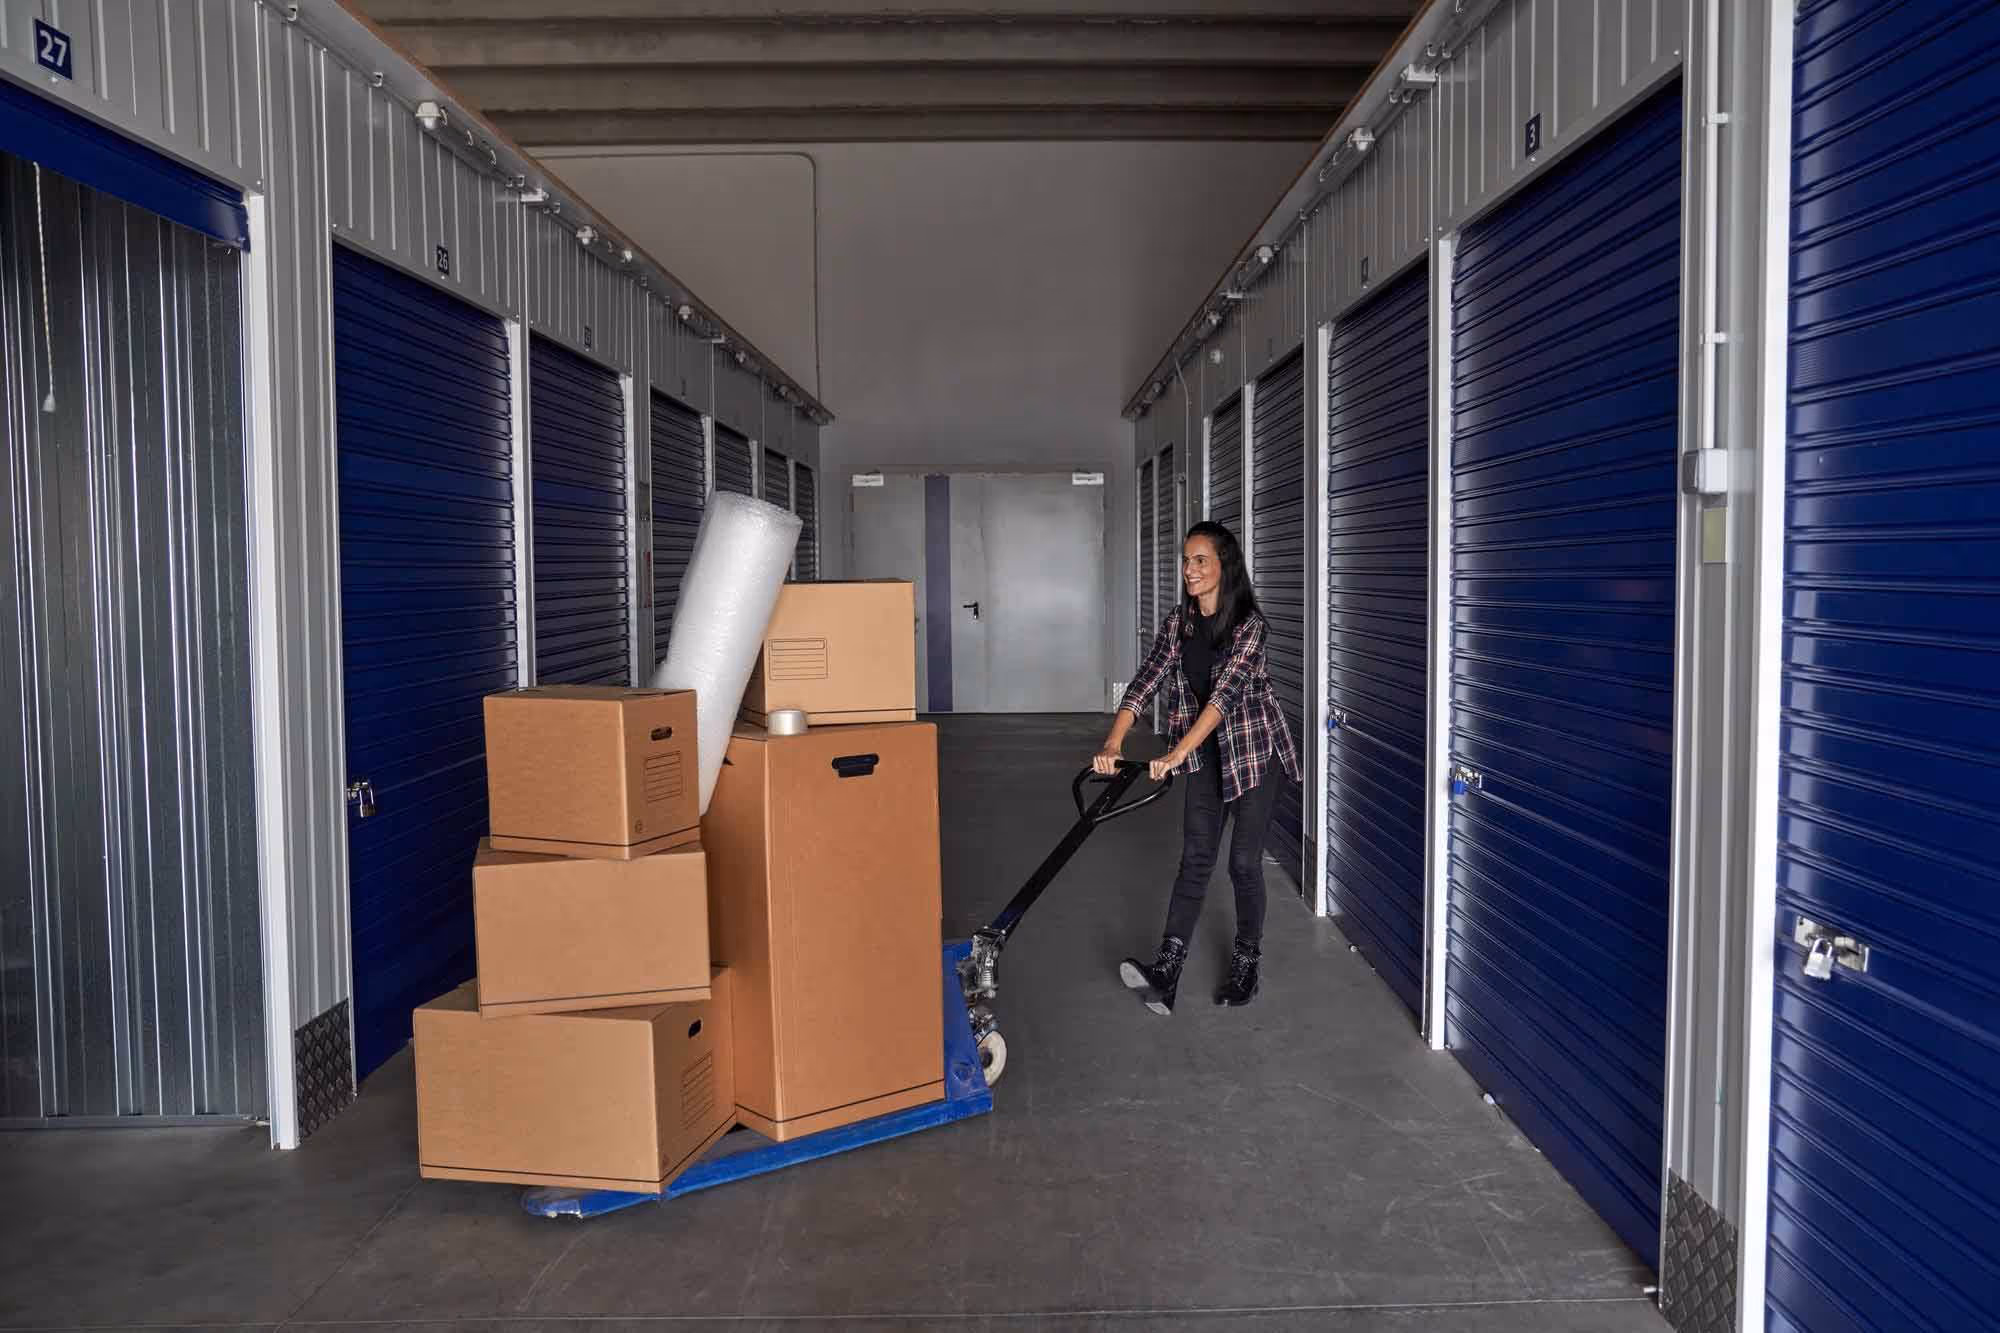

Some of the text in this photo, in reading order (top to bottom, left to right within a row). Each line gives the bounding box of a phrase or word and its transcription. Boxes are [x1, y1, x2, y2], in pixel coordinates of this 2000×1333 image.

[40, 30, 67, 66] 27
[1529, 123, 1536, 148] 3
[438, 250, 448, 270] 26
